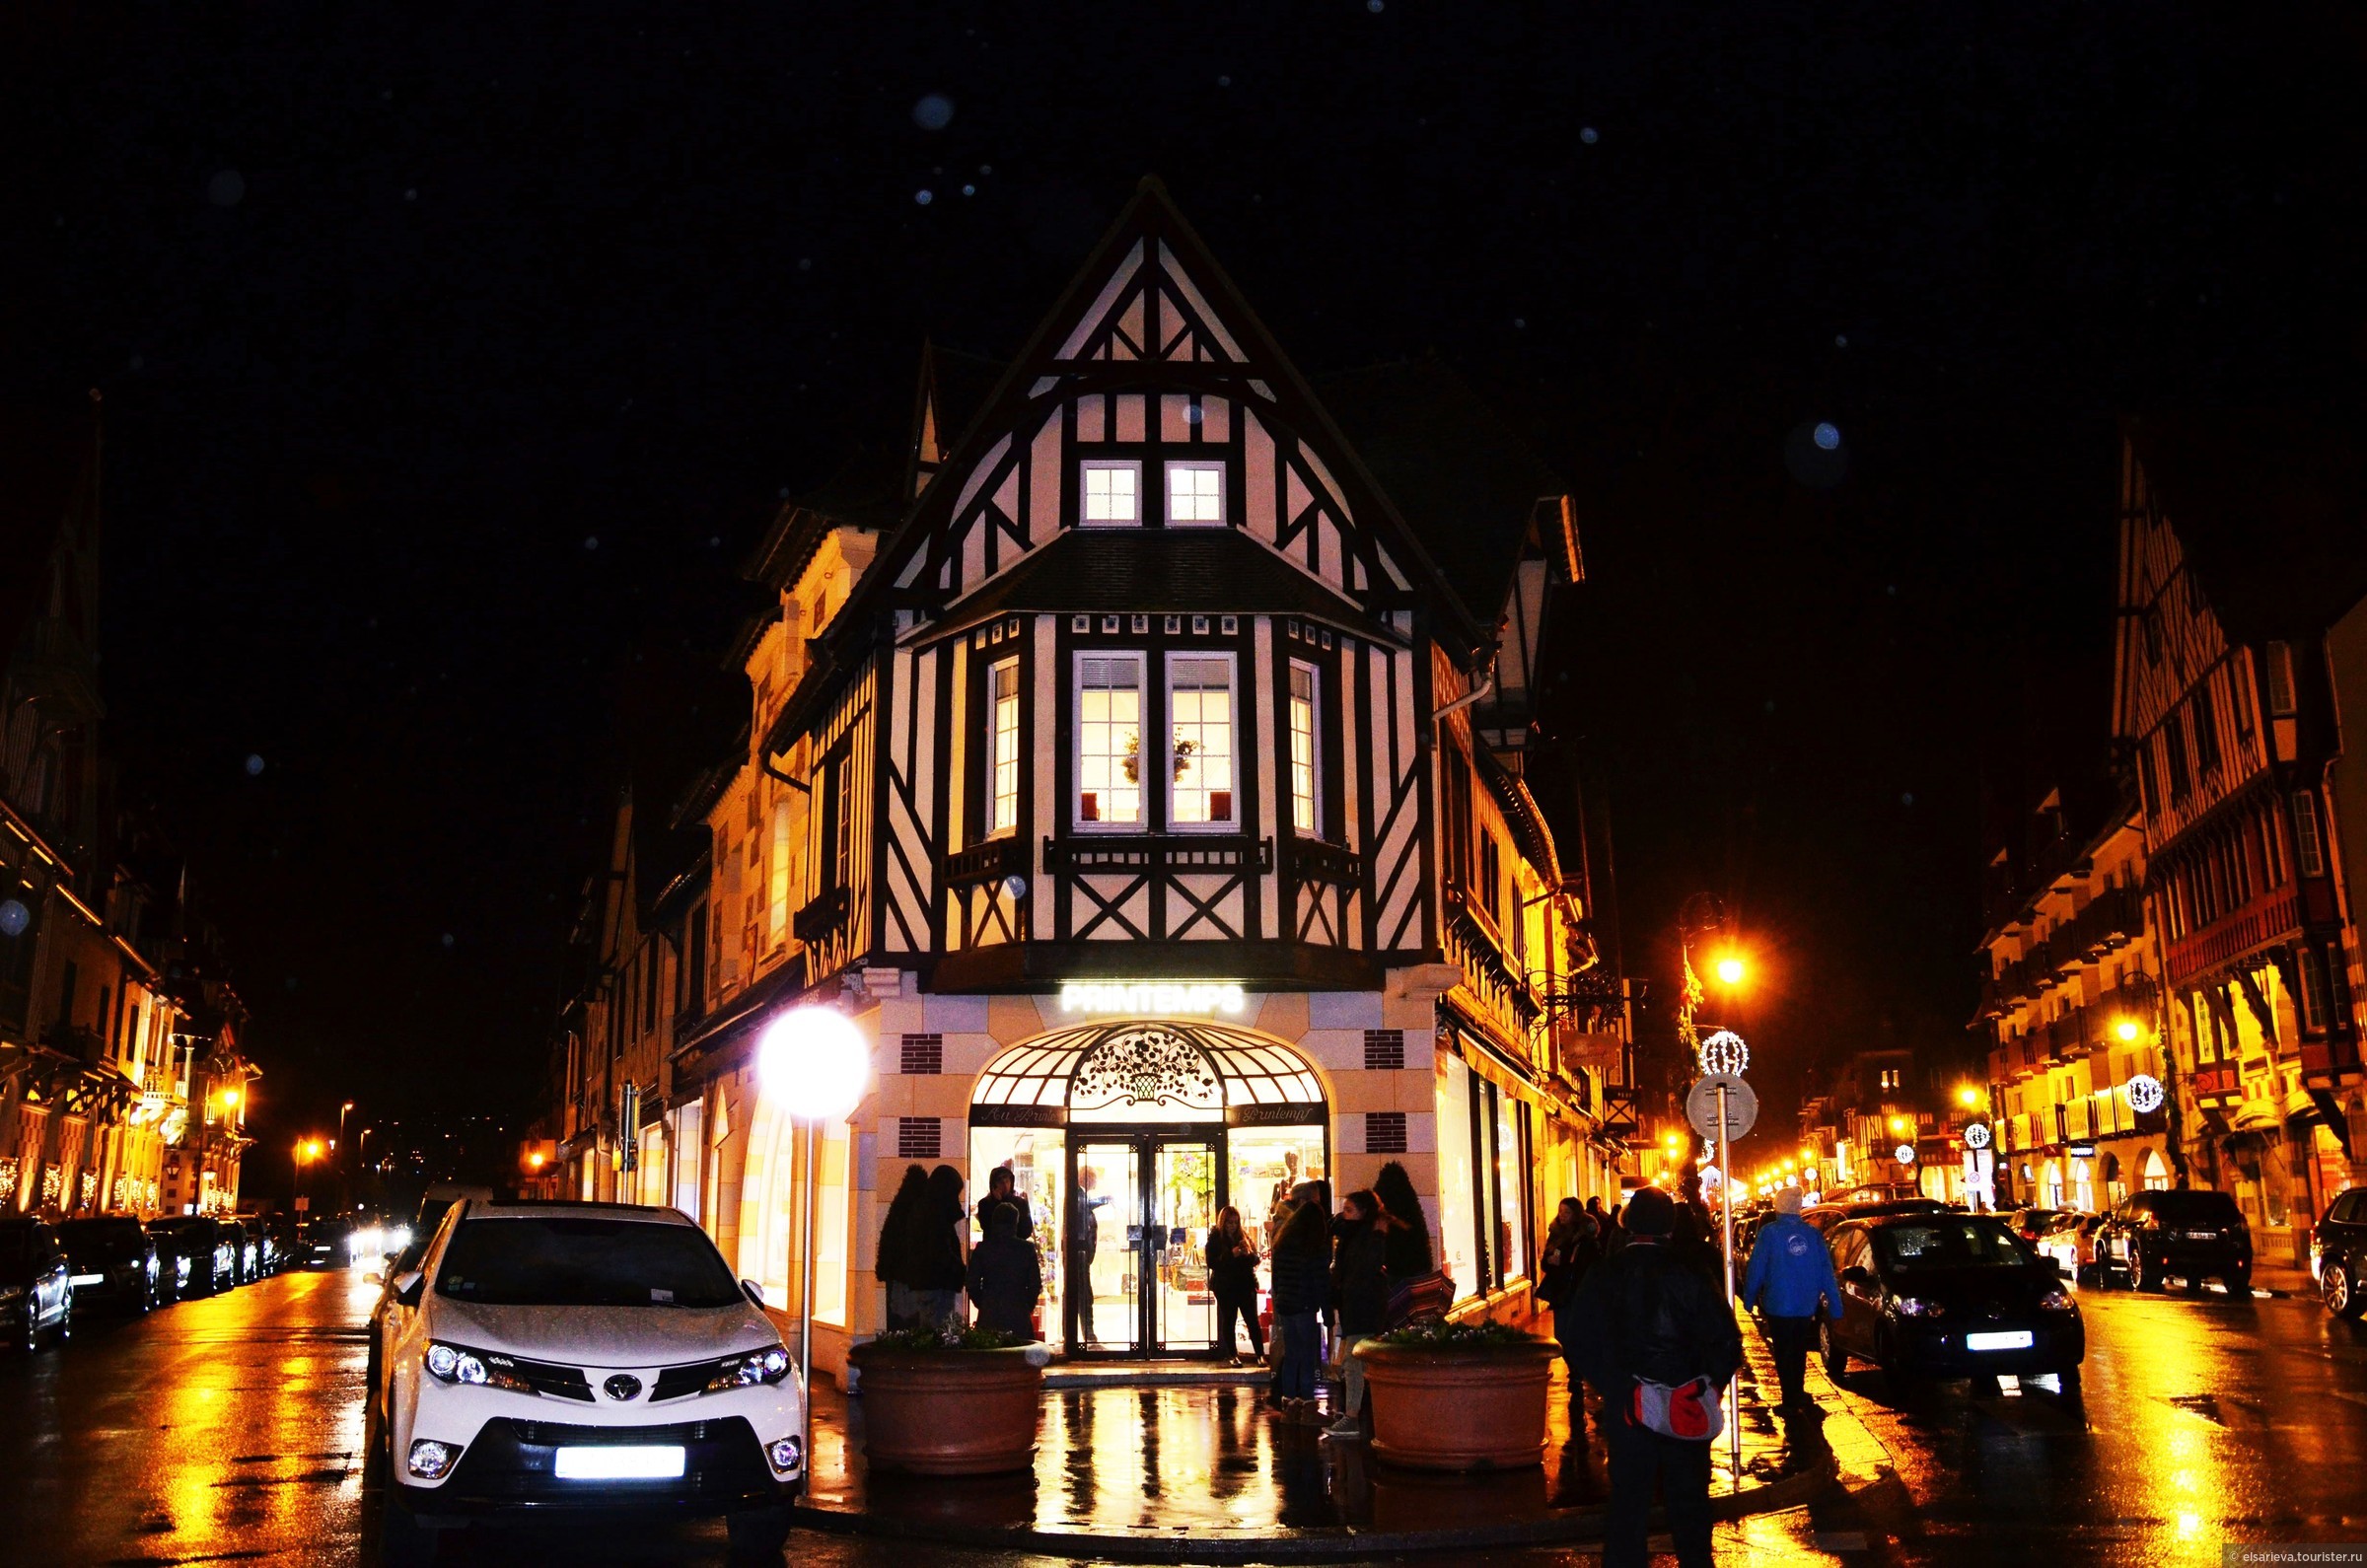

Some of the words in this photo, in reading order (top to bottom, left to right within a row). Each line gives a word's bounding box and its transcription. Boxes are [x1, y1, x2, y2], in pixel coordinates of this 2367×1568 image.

[1062, 984, 1244, 1013] PRINTEMPS
[981, 1105, 1010, 1121] Au
[1243, 1106, 1313, 1122] Printemps
